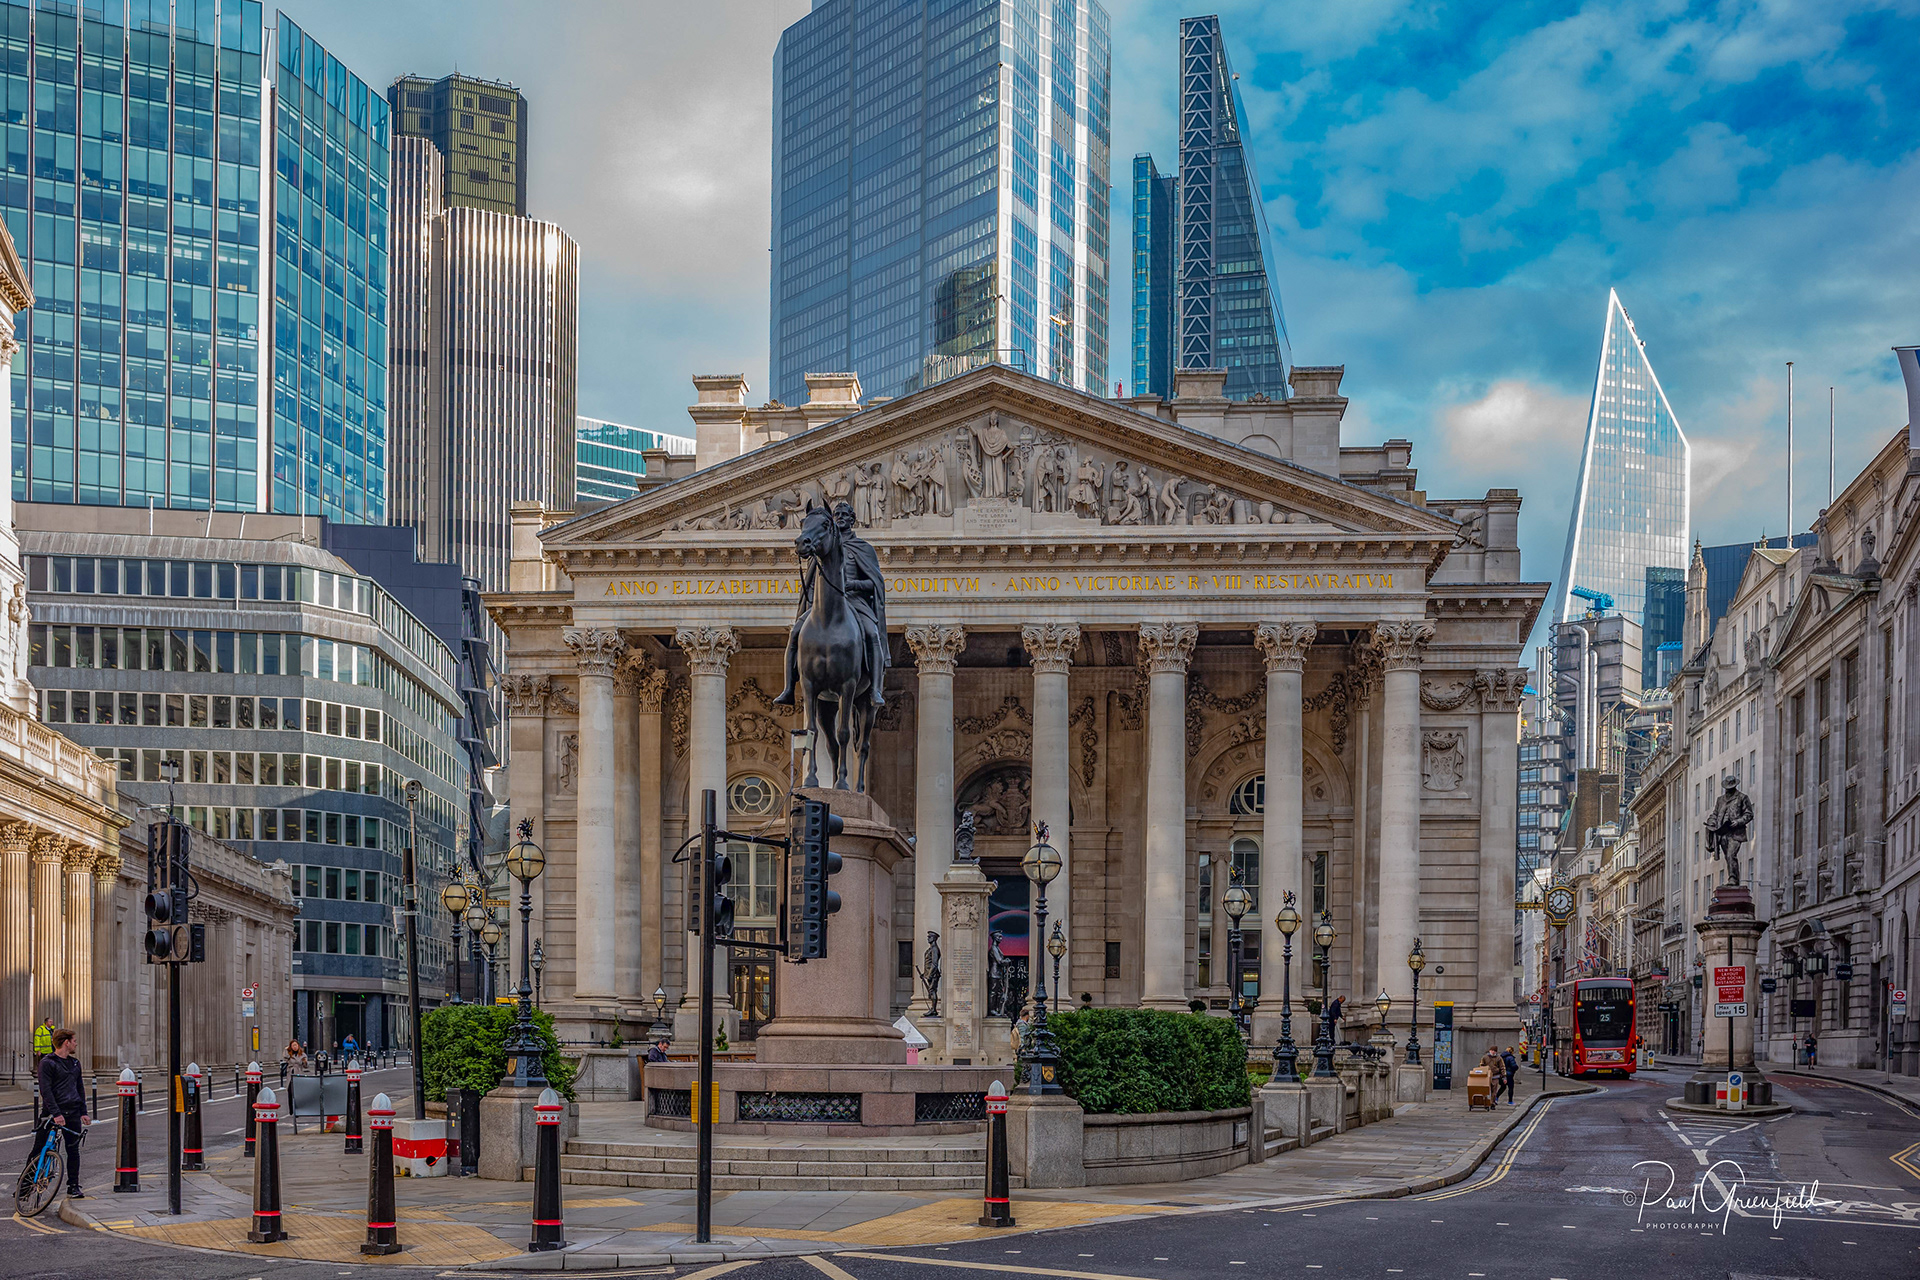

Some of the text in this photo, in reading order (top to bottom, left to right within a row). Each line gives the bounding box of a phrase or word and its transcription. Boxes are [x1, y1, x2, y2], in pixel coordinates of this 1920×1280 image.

[604, 580, 659, 595] ANNO
[1004, 577, 1060, 592] ANNO
[1073, 575, 1176, 591] VICTORIAE
[1187, 575, 1200, 590] R
[1212, 575, 1242, 589] VIII
[1253, 573, 1393, 589] RESTAVRATVM
[1733, 1005, 1746, 1014] 15
[1600, 1014, 1610, 1022] 25
